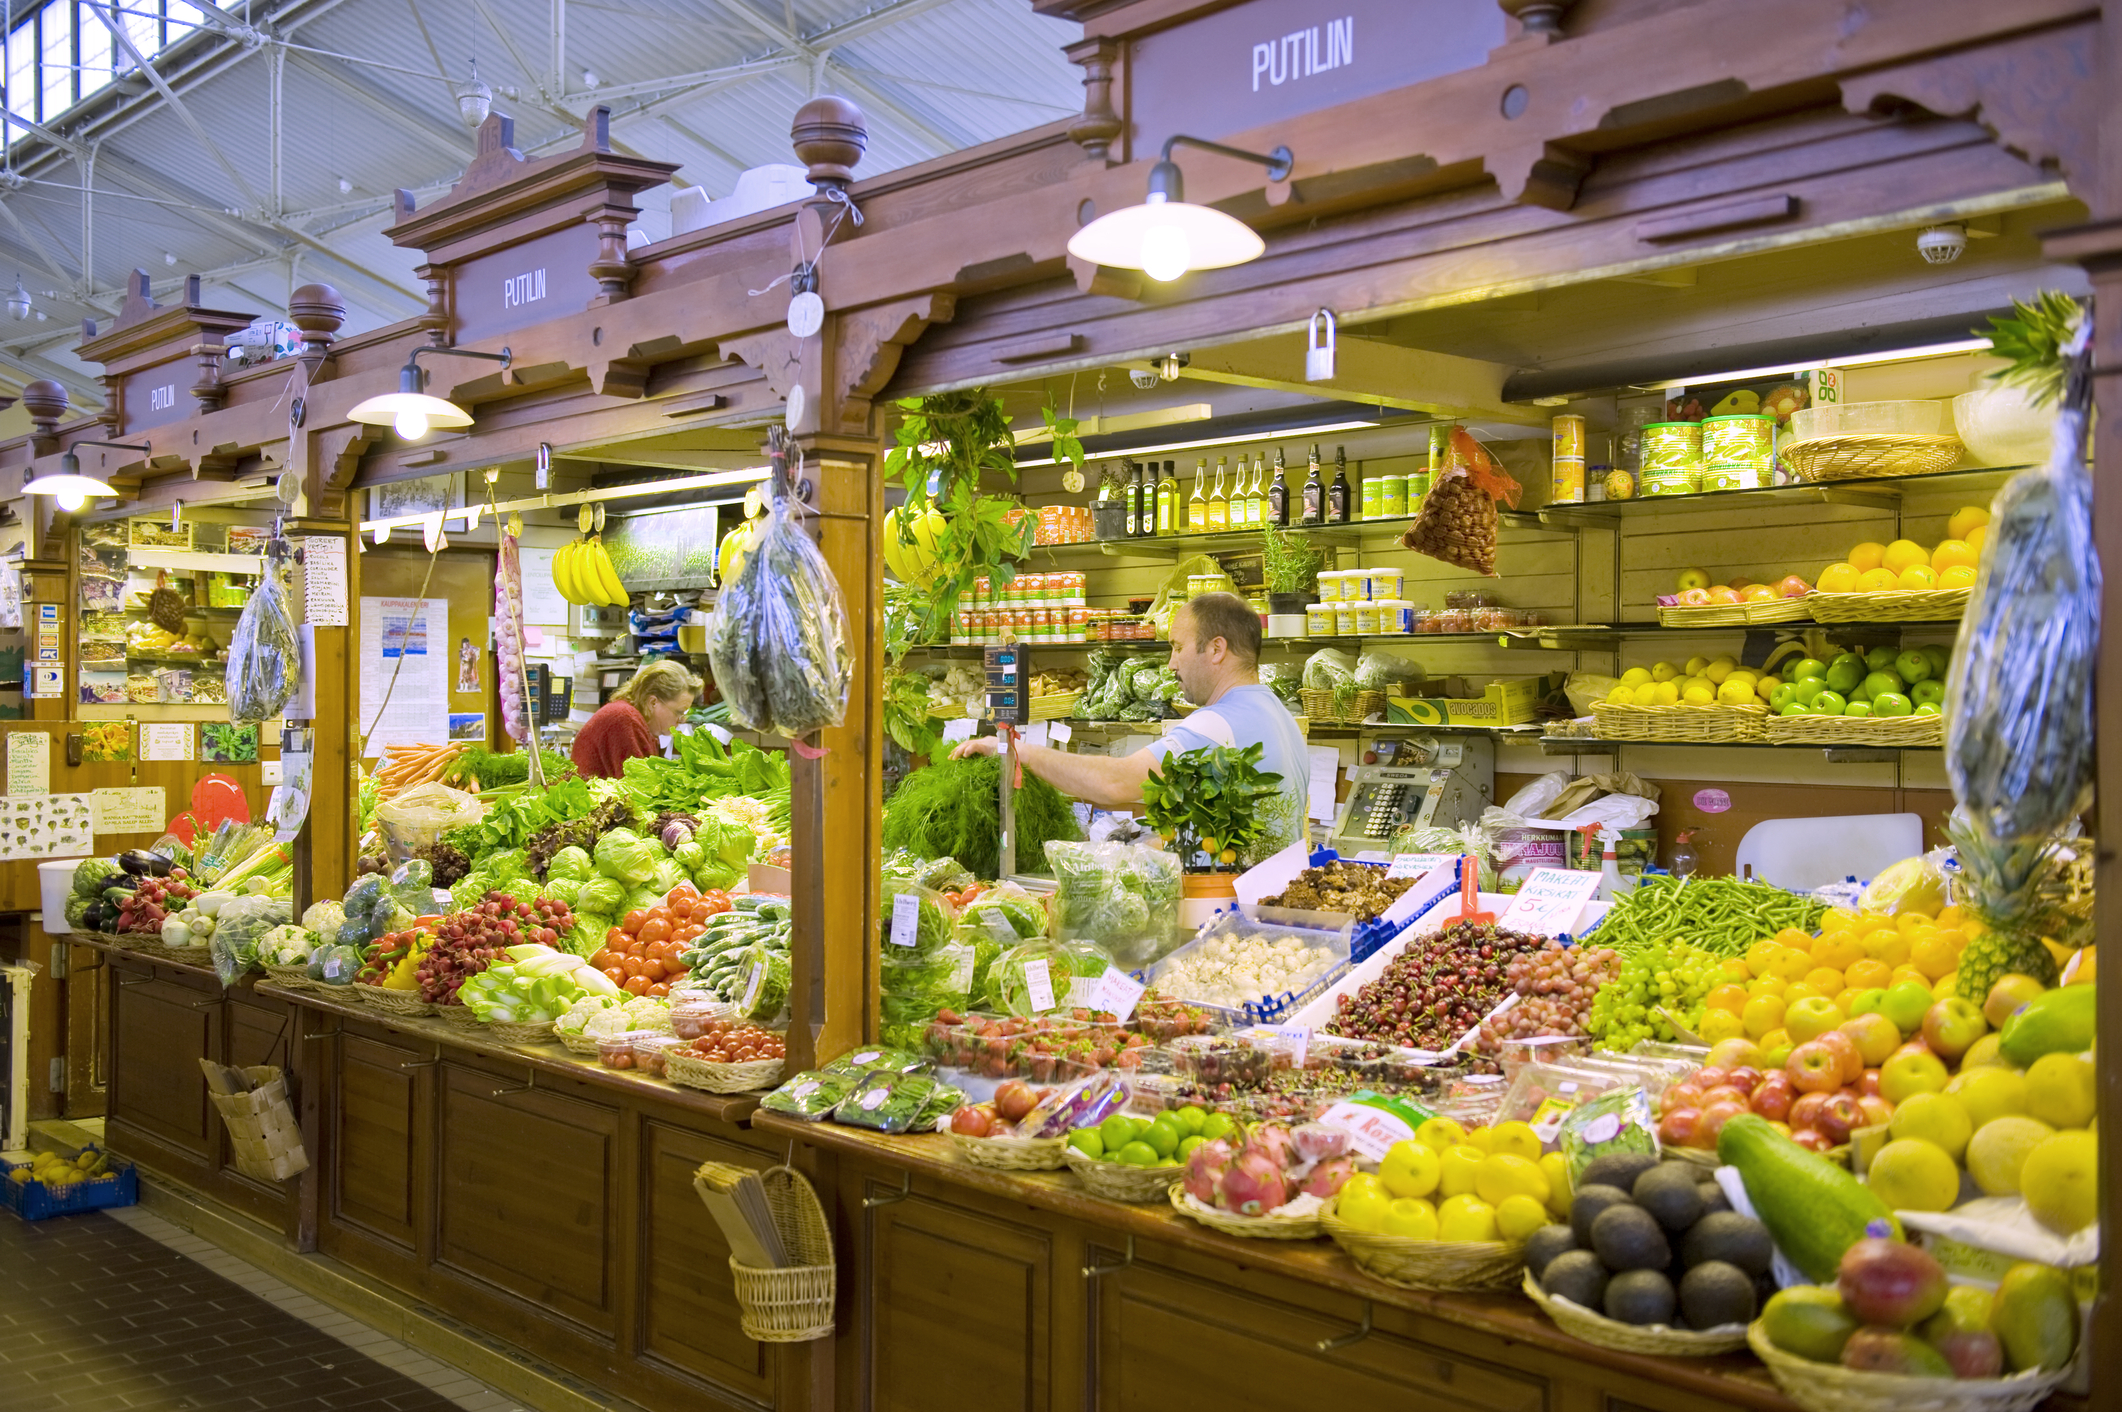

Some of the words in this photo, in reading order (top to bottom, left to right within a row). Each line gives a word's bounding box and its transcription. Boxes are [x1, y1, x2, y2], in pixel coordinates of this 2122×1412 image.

[1252, 15, 1353, 92] PUTILIN
[504, 268, 546, 309] PUTILIN
[151, 384, 175, 411] PUTILIN
[380, 600, 430, 609] KAUPPAKALENERI
[1533, 871, 1596, 887] MAKEAT
[1524, 885, 1584, 900] KIRSIKAT
[895, 898, 917, 907] Ahlberg
